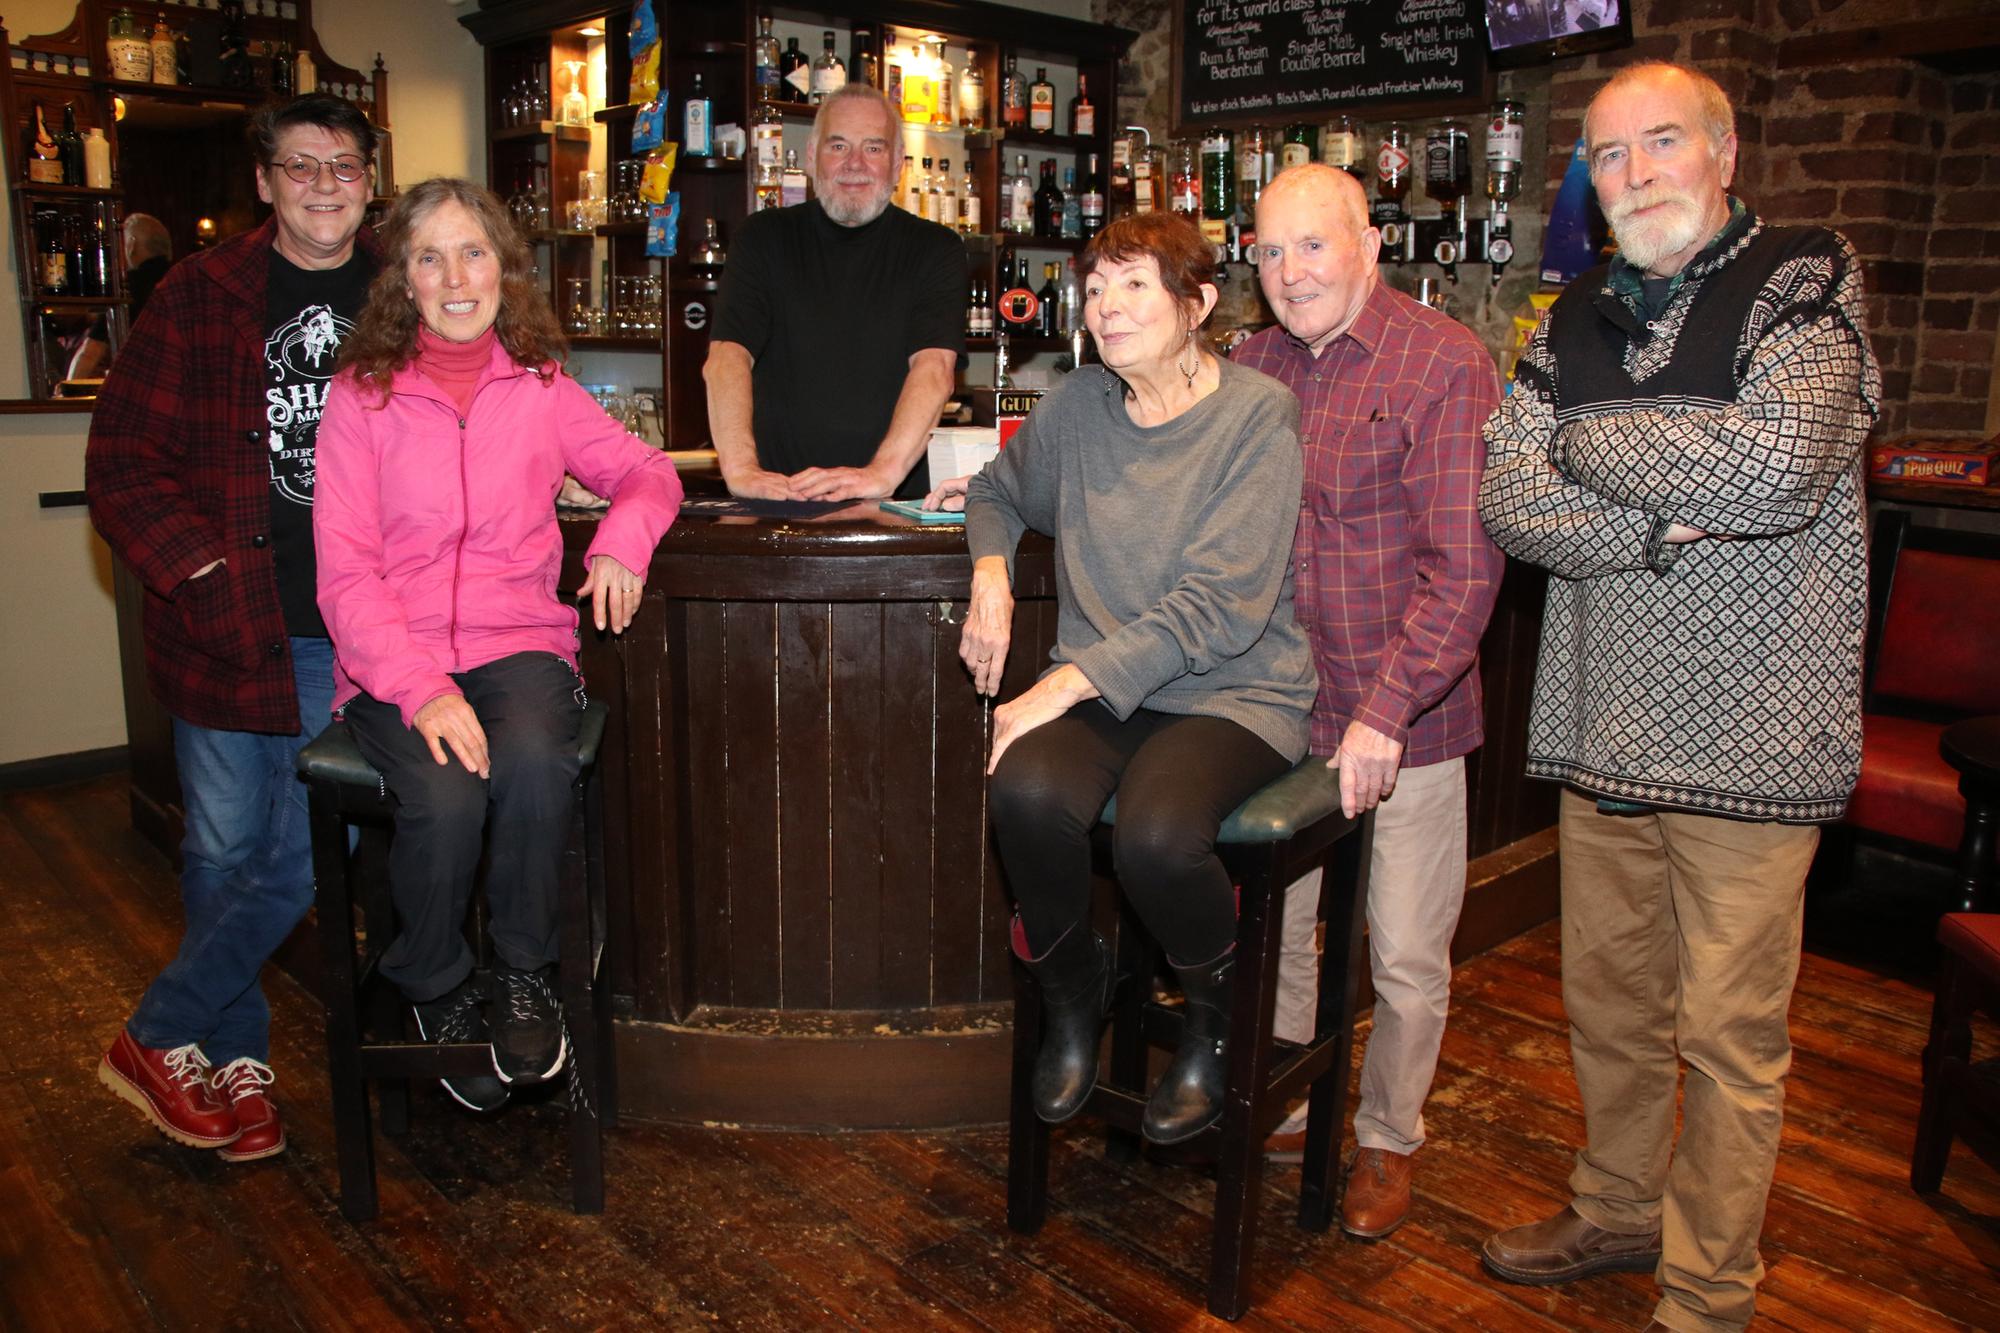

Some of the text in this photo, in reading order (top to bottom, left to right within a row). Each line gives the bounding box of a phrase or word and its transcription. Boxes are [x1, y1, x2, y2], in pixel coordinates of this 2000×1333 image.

[1197, 8, 1216, 26] for
[1222, 4, 1239, 21] its
[1243, 0, 1280, 18] world
[1283, 0, 1315, 12] class
[1288, 33, 1355, 56] Single Malt
[1380, 22, 1474, 51] Single Malt Irish
[1200, 46, 1269, 66] Rum & Raisin
[1280, 45, 1365, 73] Double Barrel
[1403, 43, 1458, 66] Whiskey
[1385, 80, 1421, 94] Frontier
[1422, 75, 1464, 93] Whiskey
[295, 409, 323, 424] MA
[280, 448, 316, 460] DIR
[1910, 462, 1933, 476] PUB
[1934, 460, 1965, 476] QUIZ
